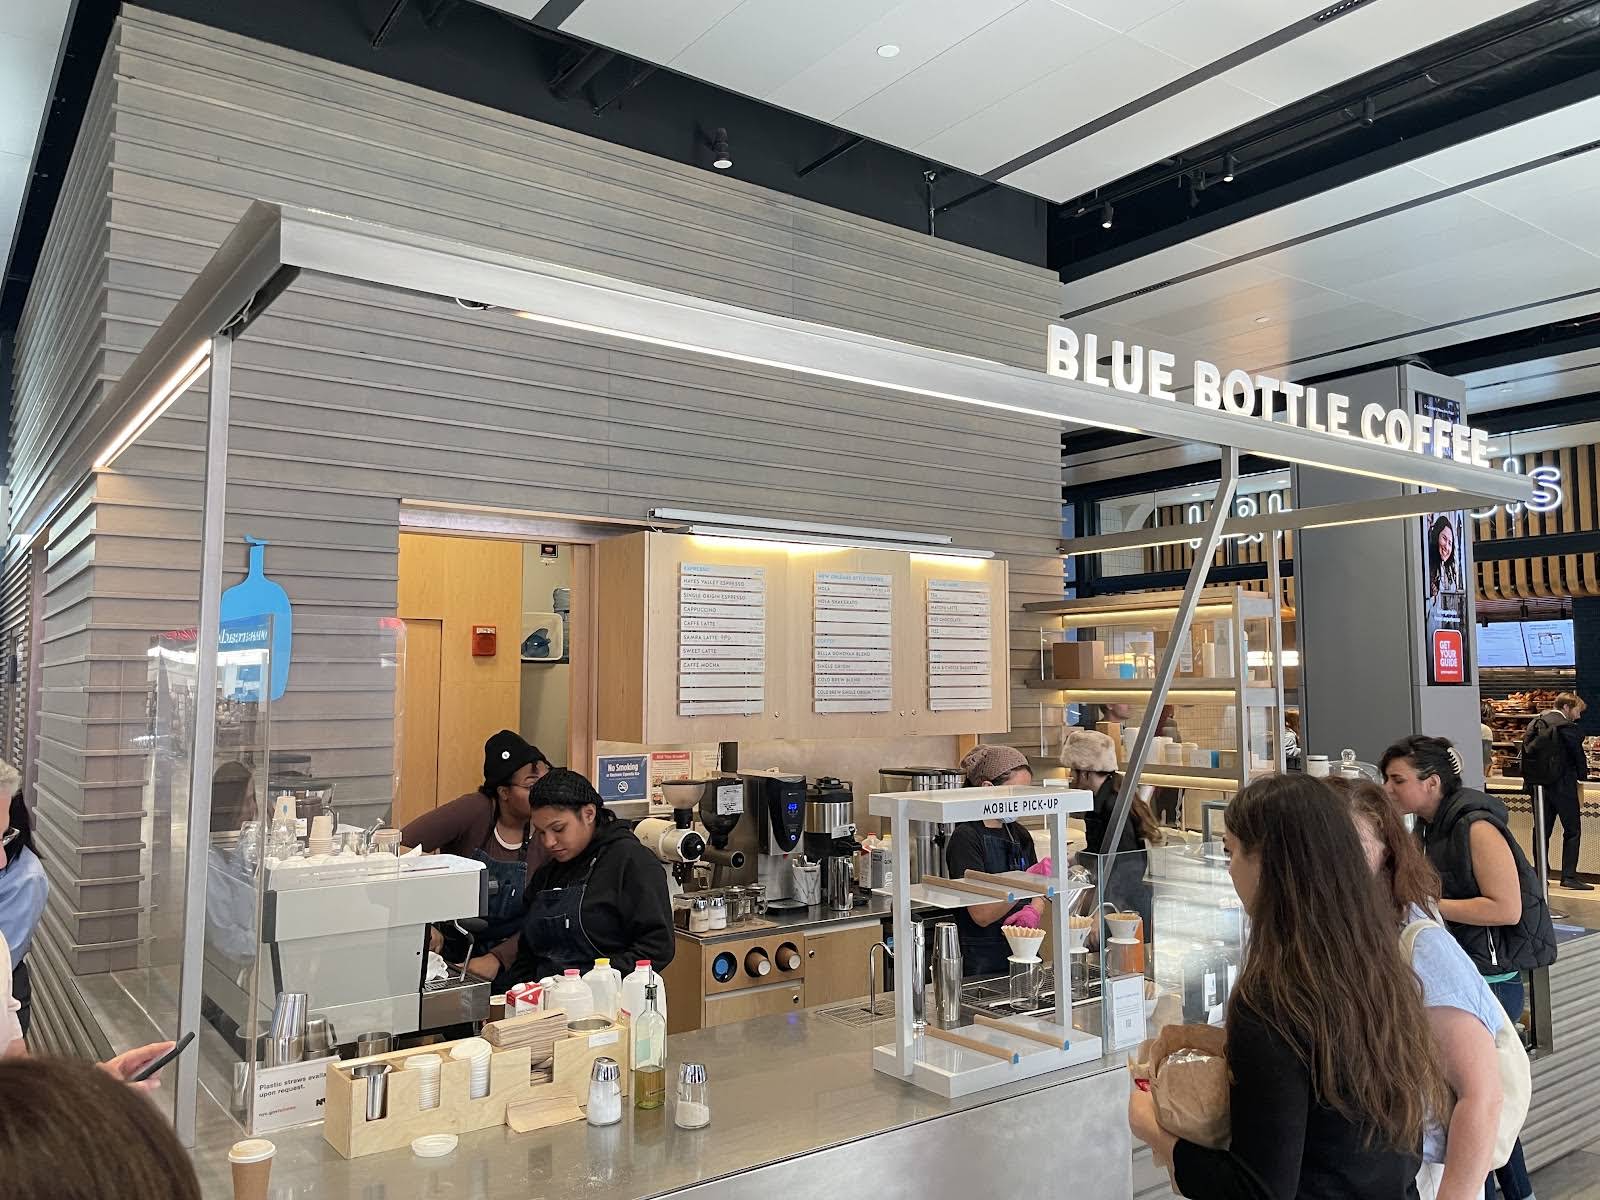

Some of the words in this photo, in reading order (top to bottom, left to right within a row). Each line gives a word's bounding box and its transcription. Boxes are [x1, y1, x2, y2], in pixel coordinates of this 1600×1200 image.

[1046, 324, 1176, 402] BLUE
[1194, 360, 1350, 436] BOTTLE
[1361, 402, 1490, 468] COFFEE
[1439, 640, 1451, 650] GET
[1440, 649, 1457, 659] YOUR
[1440, 658, 1458, 667] GUIDE
[607, 763, 616, 772] No
[616, 762, 639, 772] Smoking
[983, 801, 1018, 815] MOBILE
[1023, 798, 1059, 812] PICK-UP
[259, 1082, 282, 1091] Plastic
[283, 1077, 306, 1085] straws
[259, 1089, 278, 1098] upon
[277, 1084, 306, 1094] request.
